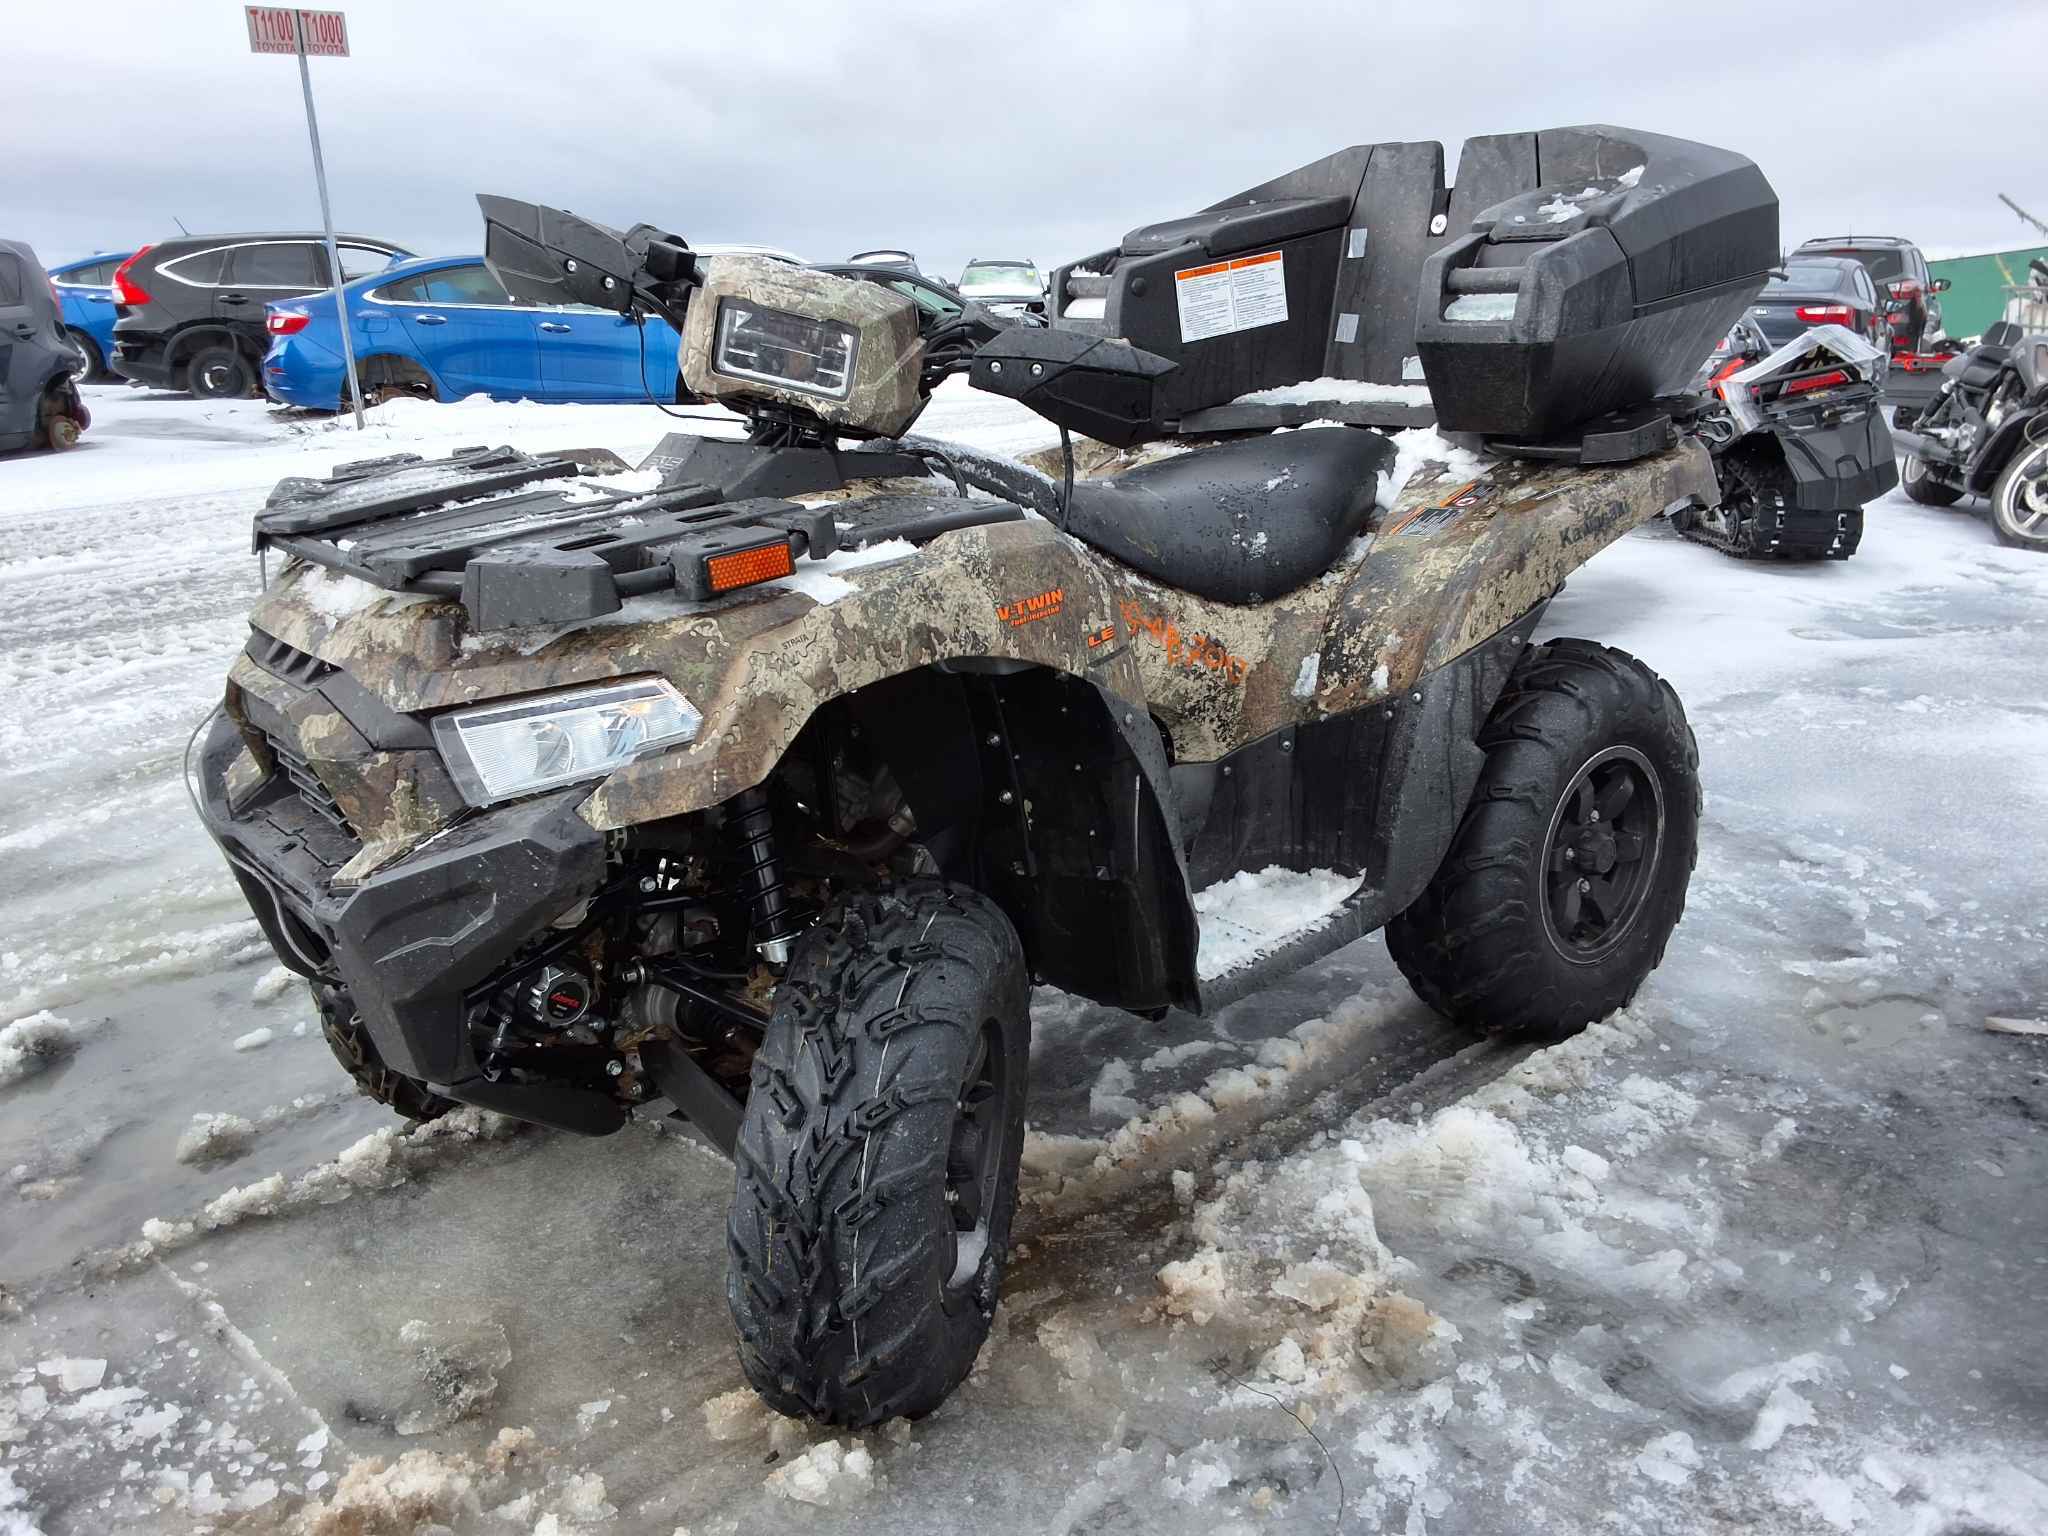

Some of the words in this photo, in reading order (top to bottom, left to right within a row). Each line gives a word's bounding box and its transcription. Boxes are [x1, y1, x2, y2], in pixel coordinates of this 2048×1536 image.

[250, 9, 294, 41] T1100
[301, 12, 344, 43] T1000
[256, 41, 297, 53] TOYOTA
[306, 43, 347, 55] TOYOTA
[995, 587, 1064, 621] V-TWIN
[1087, 624, 1116, 649] LE
